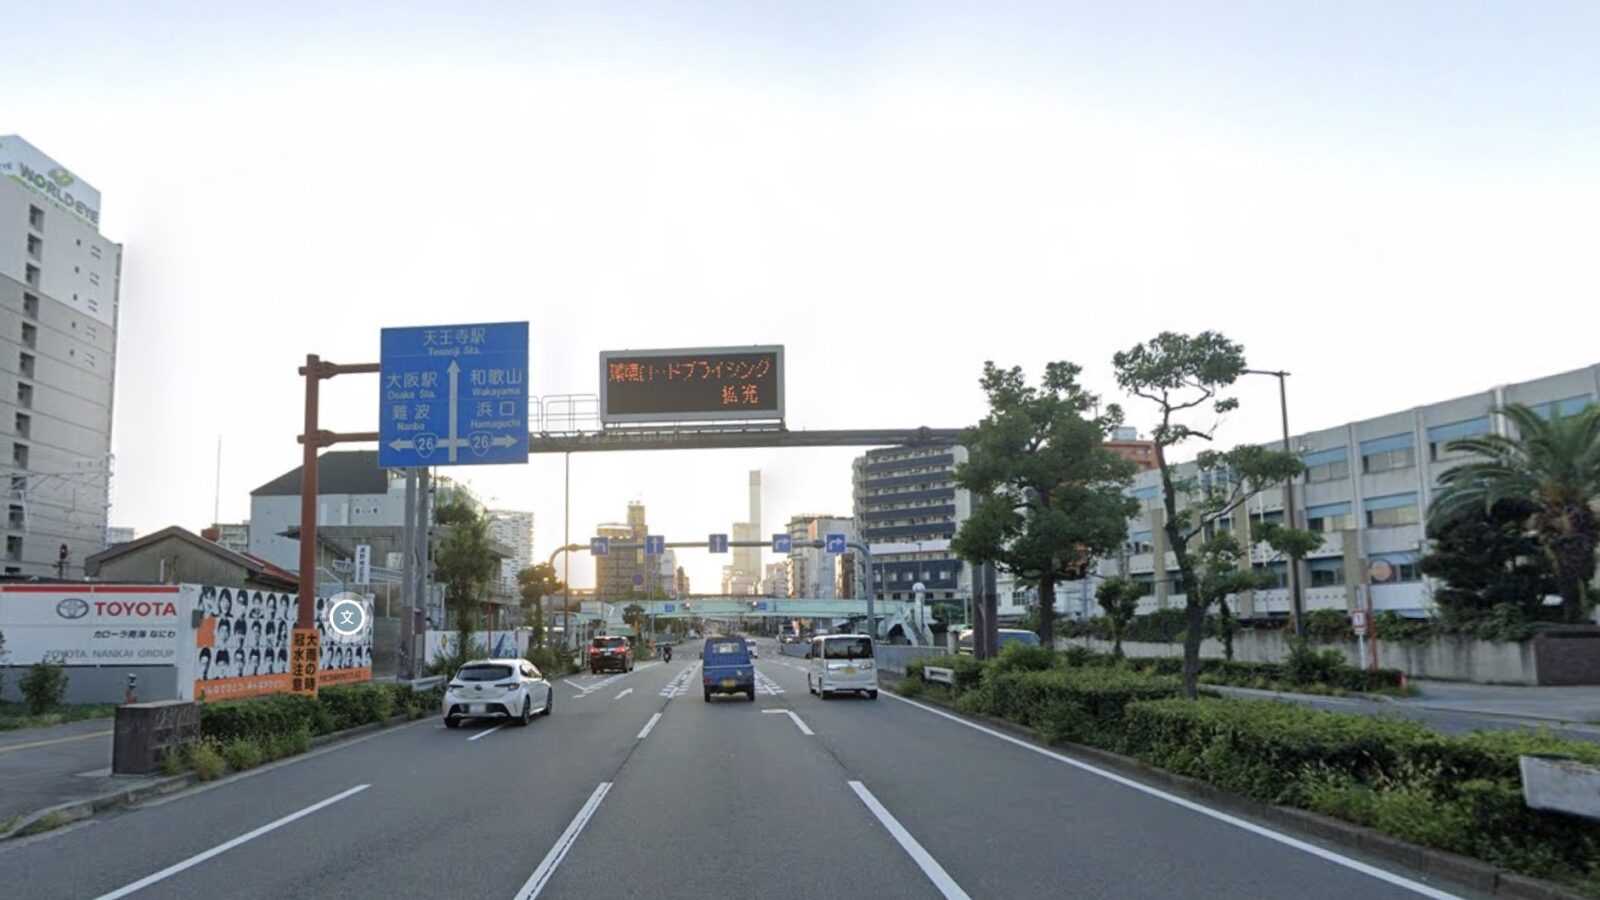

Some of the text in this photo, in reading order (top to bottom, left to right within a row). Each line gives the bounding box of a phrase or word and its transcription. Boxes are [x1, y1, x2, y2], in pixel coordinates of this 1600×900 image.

[423, 327, 486, 346] 天王寺駅
[386, 371, 438, 389] 大阪駅
[470, 368, 522, 385] 和歌山
[387, 390, 415, 400] Osaka
[472, 387, 521, 398] Wakayama
[392, 404, 431, 421] 難波
[476, 401, 515, 417] 浜口
[470, 419, 521, 430] Hamaguchi
[418, 438, 434, 451] 26
[473, 435, 489, 449] 26
[95, 601, 177, 617] TOYOTA
[150, 630, 176, 639] なにわ
[43, 649, 175, 659] TOYOTA NANKAI GROUP
[305, 633, 318, 691] 大雨の時
